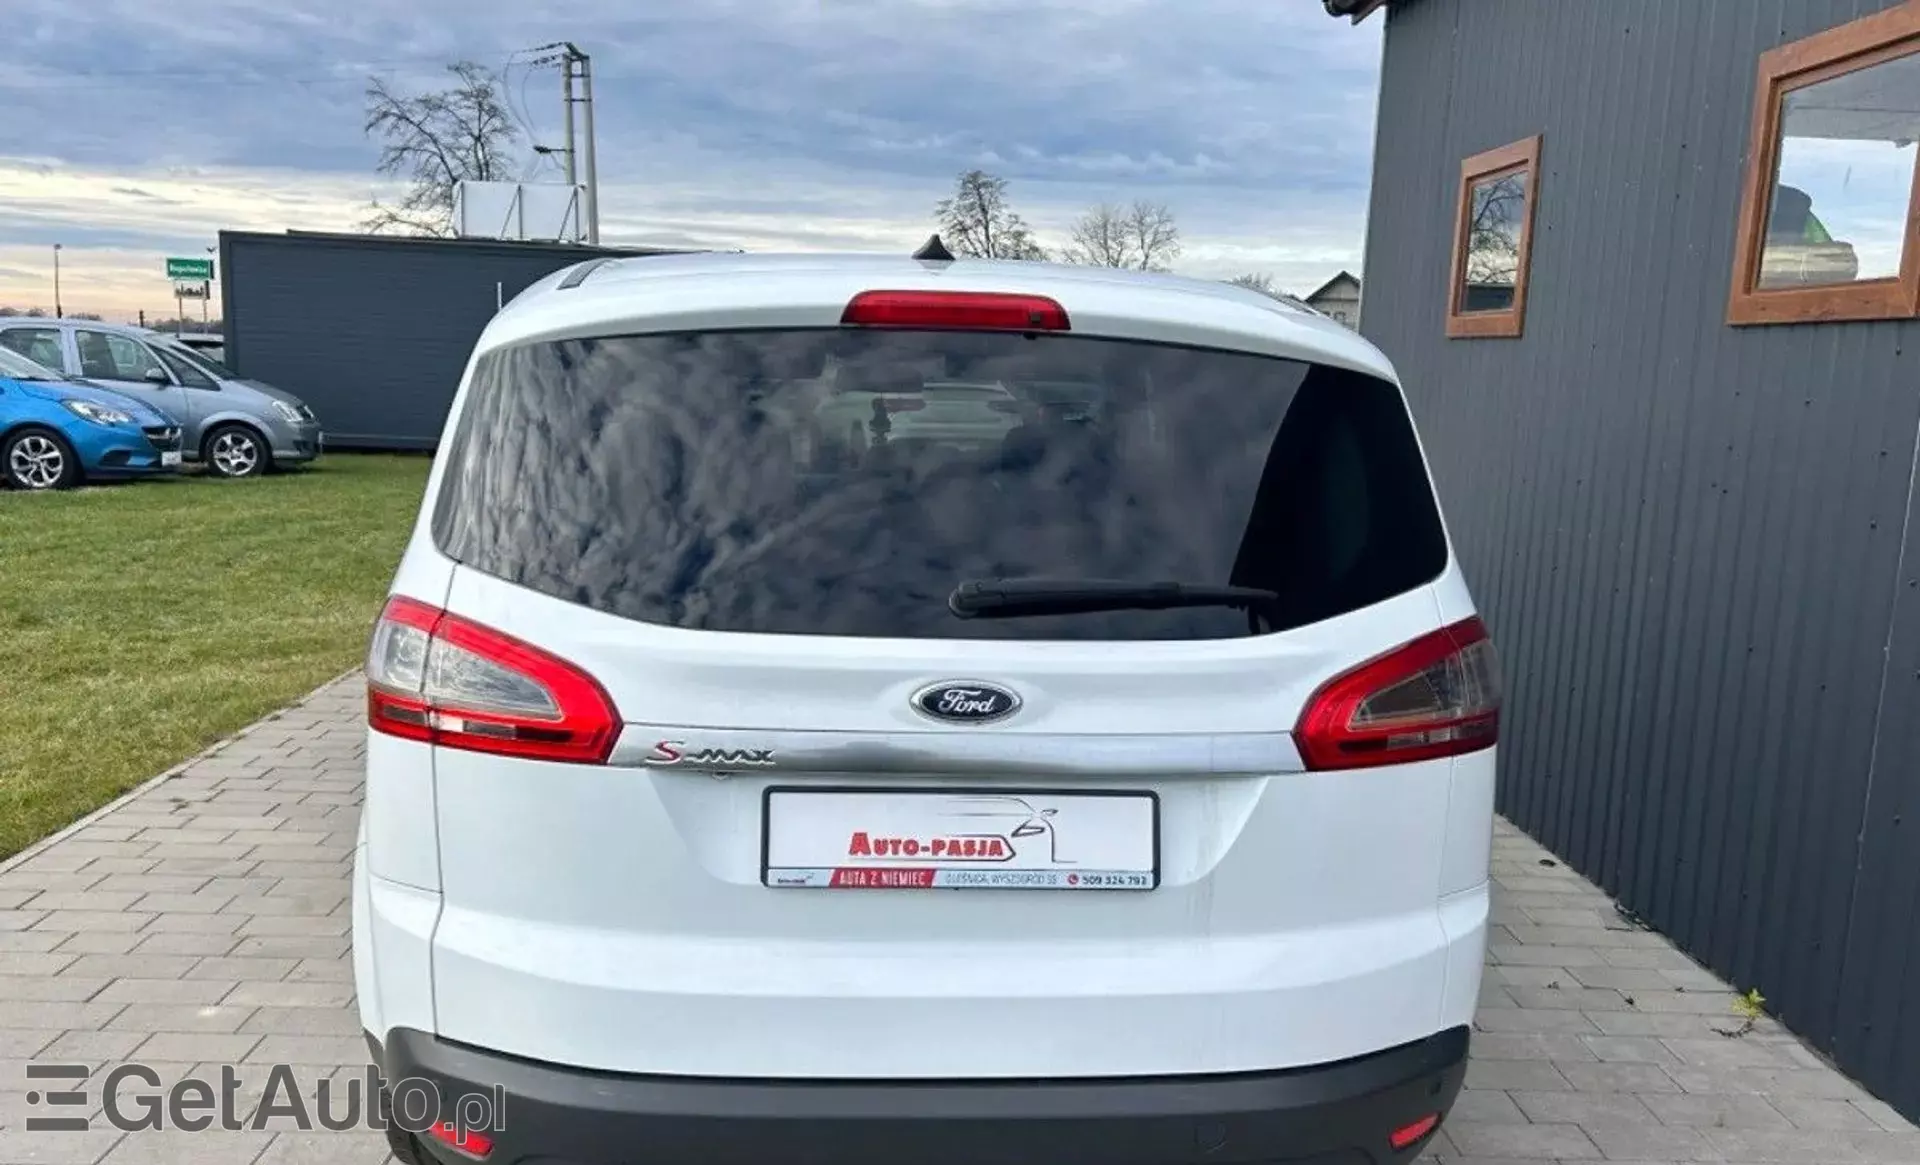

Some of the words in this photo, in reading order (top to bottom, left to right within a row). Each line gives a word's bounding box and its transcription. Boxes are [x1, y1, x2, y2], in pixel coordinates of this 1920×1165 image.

[938, 689, 997, 713] Ford
[840, 870, 866, 886] AUTA
[870, 870, 878, 886] Z
[881, 870, 925, 886] NIEMIEC
